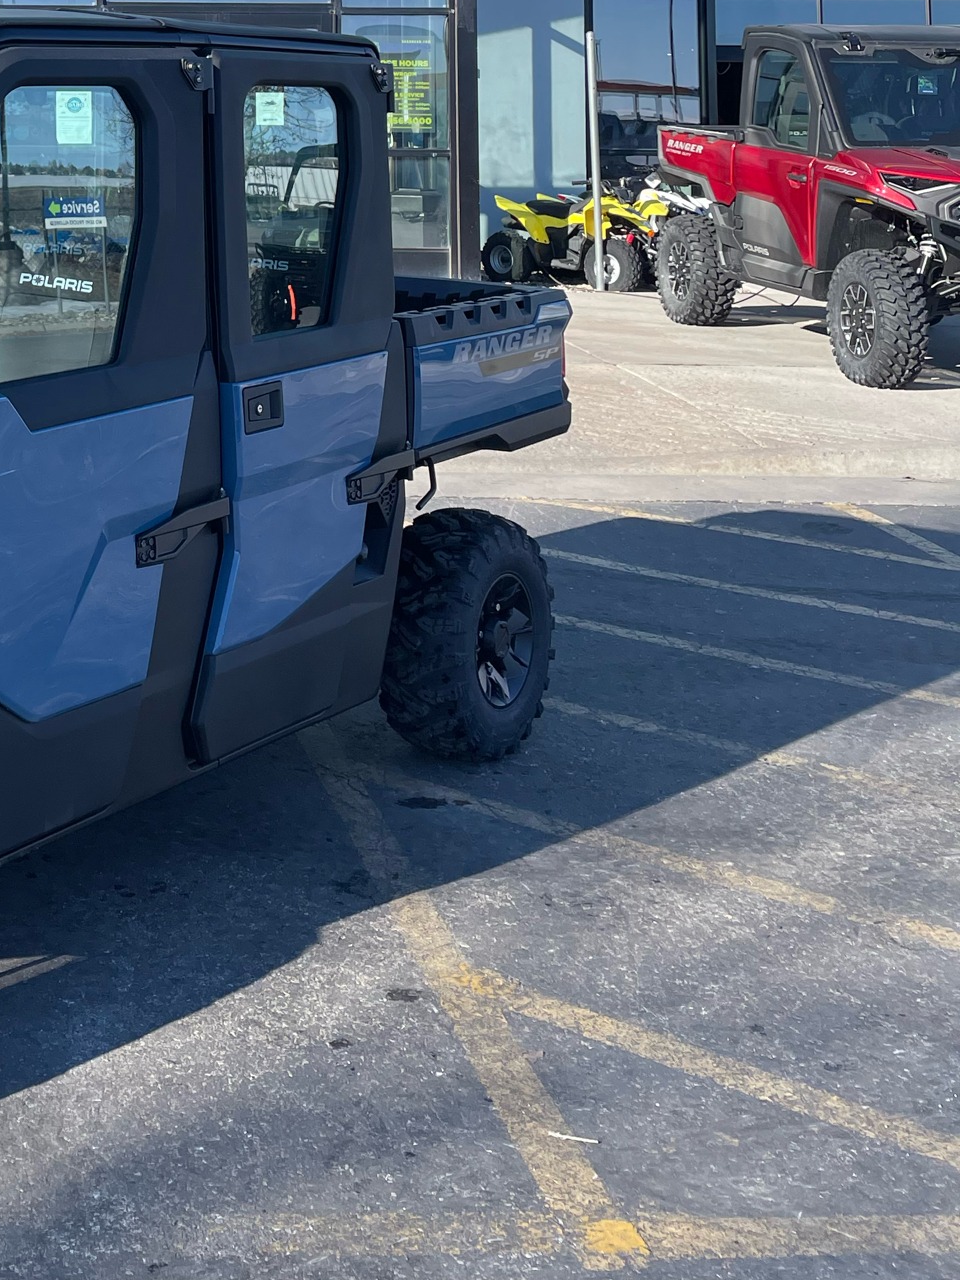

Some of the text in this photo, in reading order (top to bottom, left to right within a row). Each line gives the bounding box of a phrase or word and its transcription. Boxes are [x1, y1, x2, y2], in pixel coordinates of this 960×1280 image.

[399, 59, 428, 67] HOURS
[667, 138, 704, 154] RANGER
[823, 164, 857, 176] 1500
[742, 242, 770, 256] POLARIS
[19, 272, 93, 293] POLARIS
[452, 325, 553, 363] RANGER
[532, 346, 560, 362] SP
